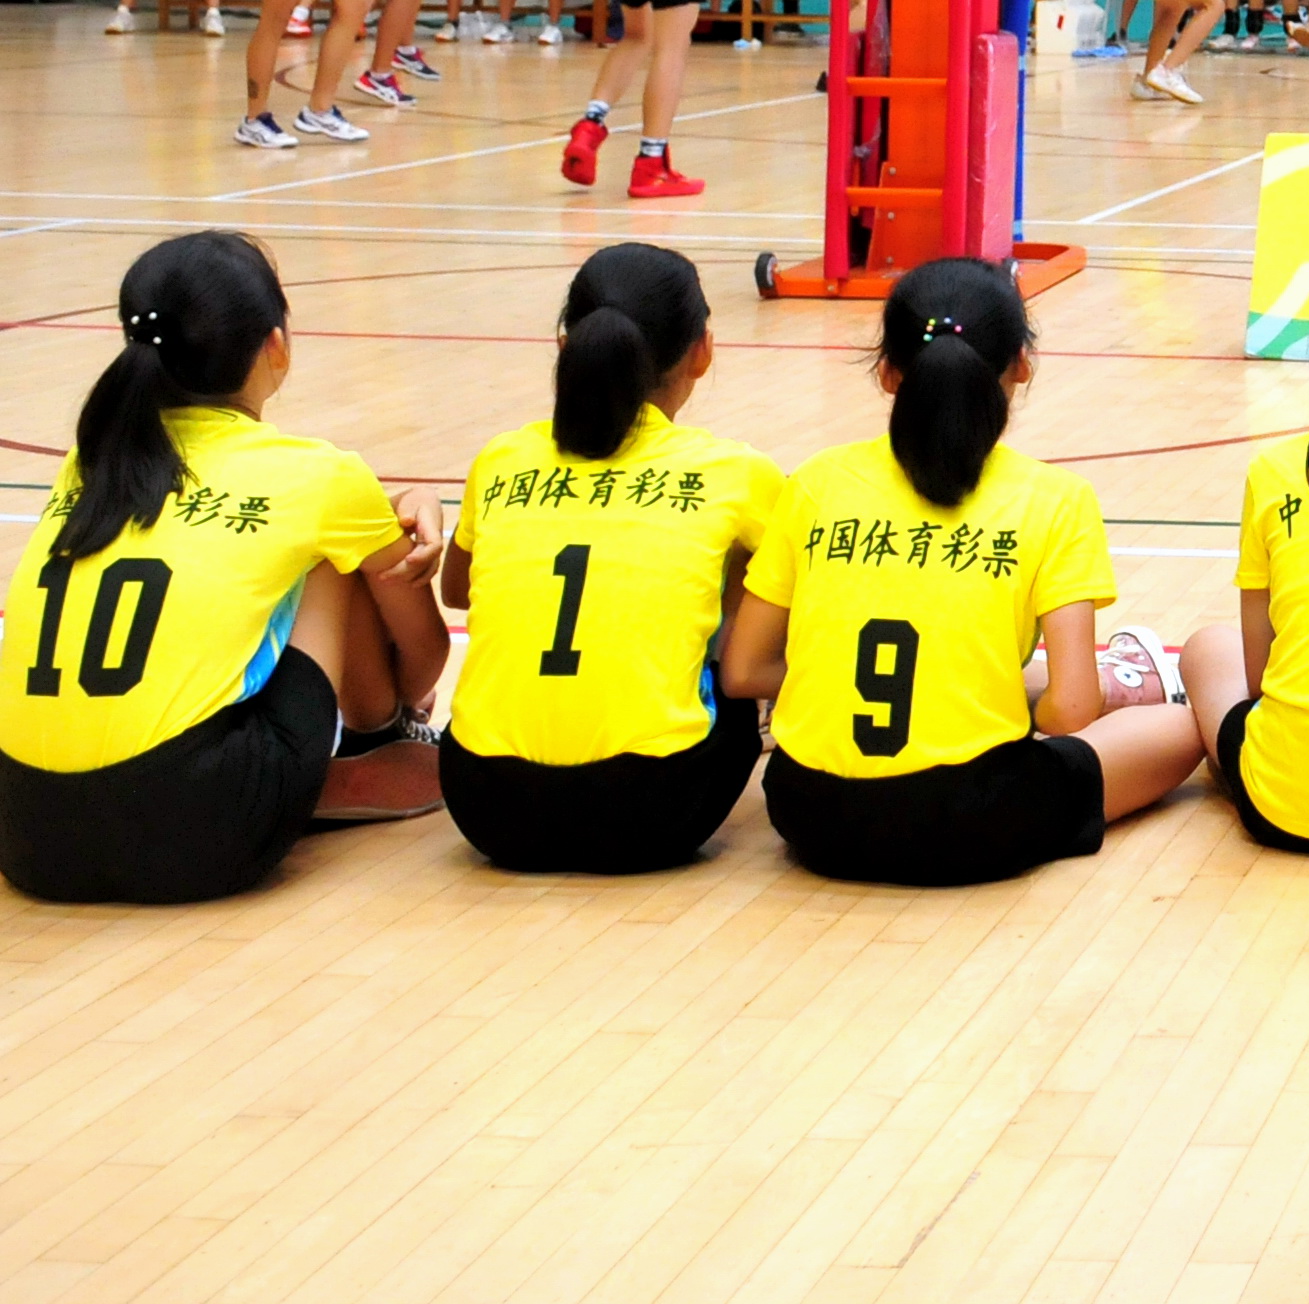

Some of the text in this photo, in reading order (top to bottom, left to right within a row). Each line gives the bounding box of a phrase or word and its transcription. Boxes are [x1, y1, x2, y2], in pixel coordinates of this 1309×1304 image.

[482, 466, 707, 521] 中国体育彩票
[804, 516, 1019, 580] 中国体育彩票
[26, 555, 174, 698] 10
[538, 543, 591, 677] 1
[851, 617, 921, 758] 9
